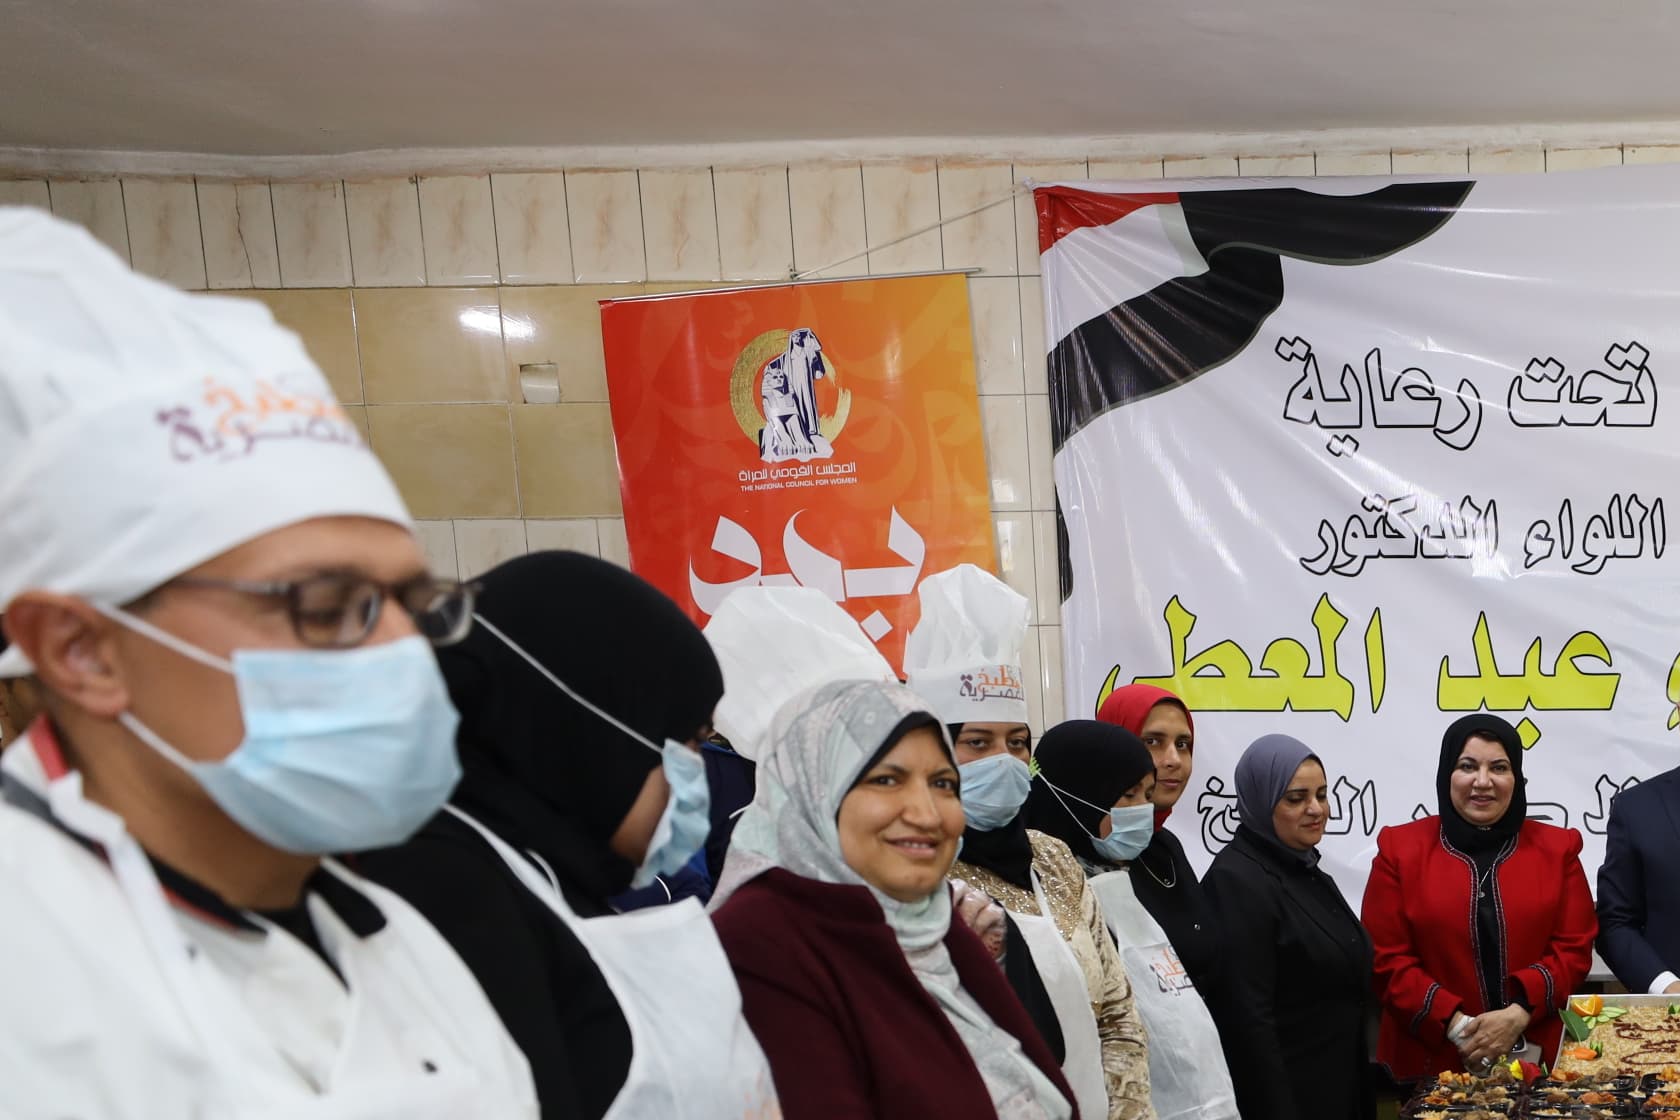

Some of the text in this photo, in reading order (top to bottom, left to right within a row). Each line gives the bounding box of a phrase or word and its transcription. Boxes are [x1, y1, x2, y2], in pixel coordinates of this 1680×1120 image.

[1275, 335, 1658, 456] تحت رعاية
[740, 484, 754, 492] THE
[754, 482, 785, 491] NATIONAL
[785, 480, 814, 489] COUNCIL
[830, 477, 858, 486] WOMEN
[1299, 493, 1667, 577] اللواء الدكتور
[1436, 610, 1622, 751] عبد
